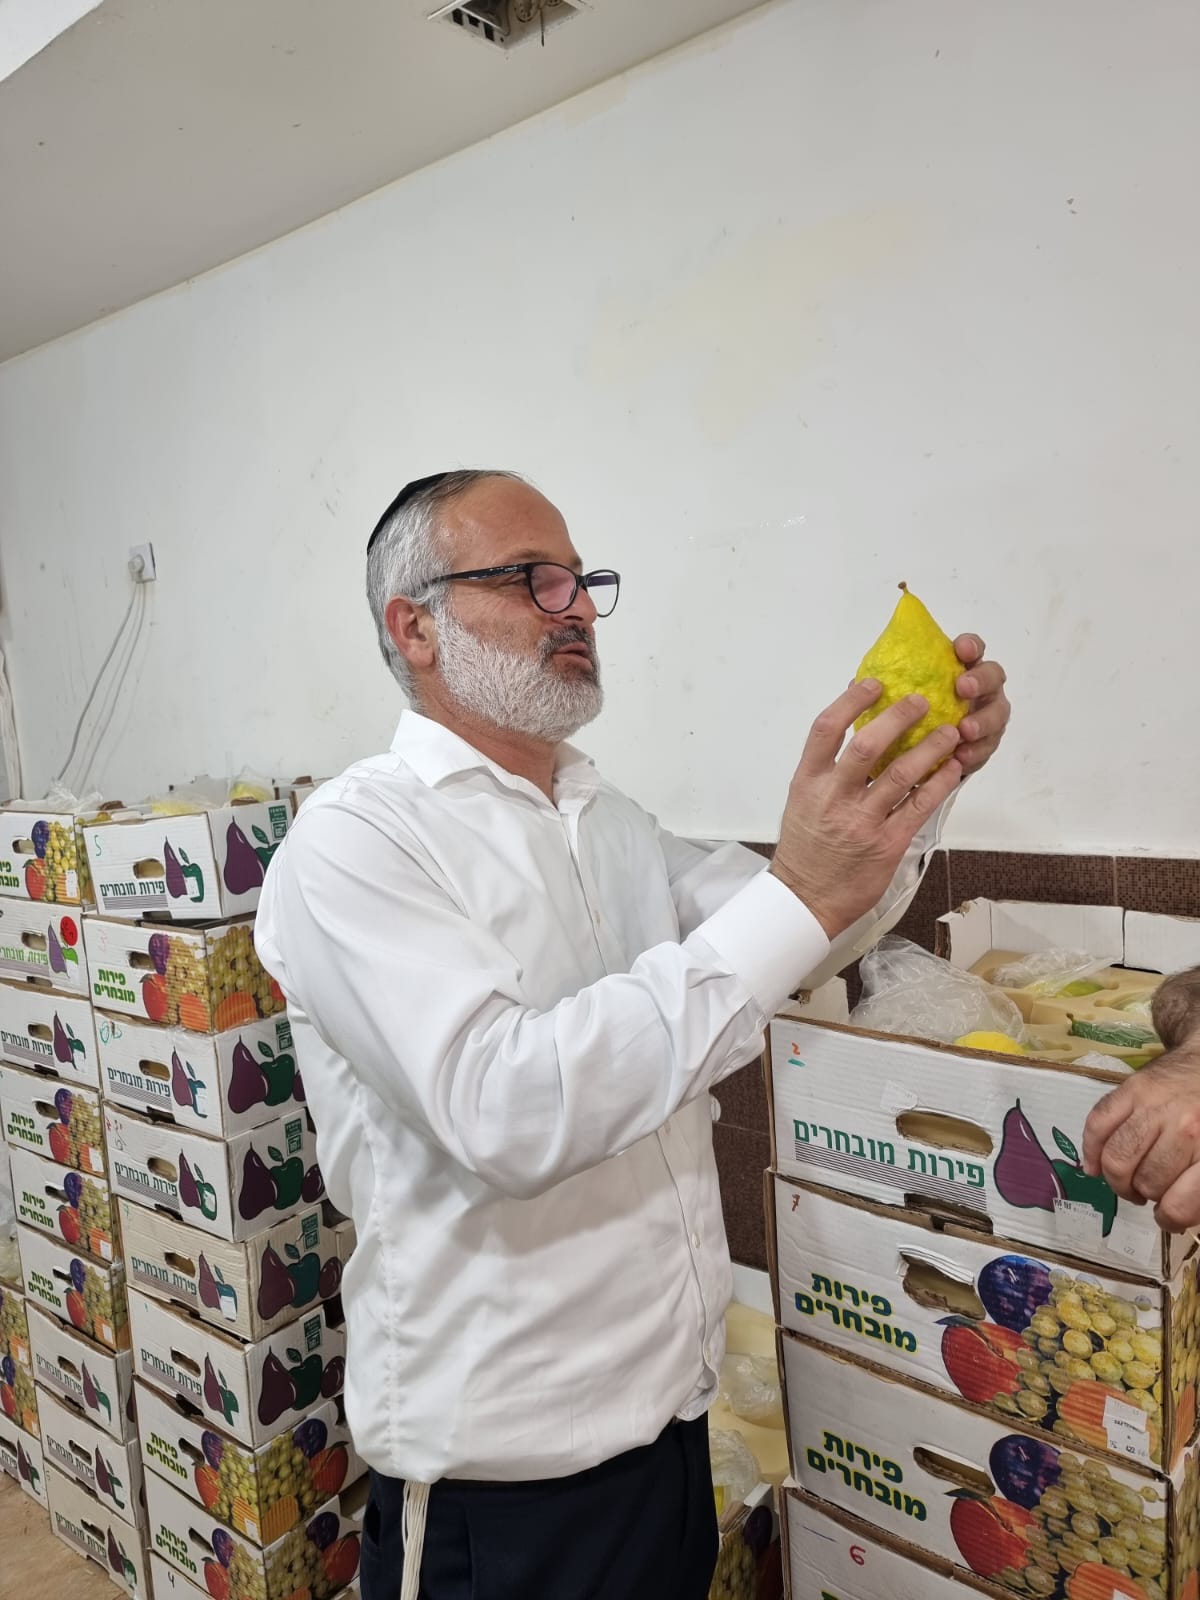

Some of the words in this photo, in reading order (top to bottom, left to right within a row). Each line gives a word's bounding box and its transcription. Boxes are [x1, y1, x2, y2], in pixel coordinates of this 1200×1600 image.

[100, 882, 136, 896] מובחרים
[139, 881, 166, 895] פירות
[98, 969, 126, 985] פירות
[94, 984, 136, 1003] מובחרים
[0, 1030, 30, 1050] מובחרים
[32, 1039, 52, 1056] פירות
[108, 1067, 142, 1088] מובחרים
[146, 1079, 170, 1096] פירות
[11, 1112, 34, 1129] פירות
[8, 1124, 43, 1145] מובחרים
[794, 1119, 895, 1165] מובחרים
[114, 1162, 149, 1186] מובחרים
[908, 1148, 984, 1188] פירות
[153, 1176, 178, 1197] פירות
[22, 1192, 46, 1210] פירות
[20, 1204, 54, 1228] מובחרים
[31, 1271, 54, 1291] פירות
[131, 1256, 168, 1282] מובחרים
[28, 1281, 62, 1308] מובחרים
[172, 1273, 197, 1295] פירות
[812, 1273, 892, 1316] פירות
[795, 1292, 917, 1352] מובחרים
[141, 1348, 175, 1378] מובחרים
[178, 1370, 202, 1396] פירות
[151, 1432, 178, 1459] פירות
[146, 1442, 188, 1479] מובחרים
[824, 1432, 902, 1484] פירות
[807, 1448, 926, 1522] מובחרים
[160, 1524, 188, 1553] פירות
[156, 1534, 197, 1574] מובחרים
[850, 1545, 866, 1566] 6
